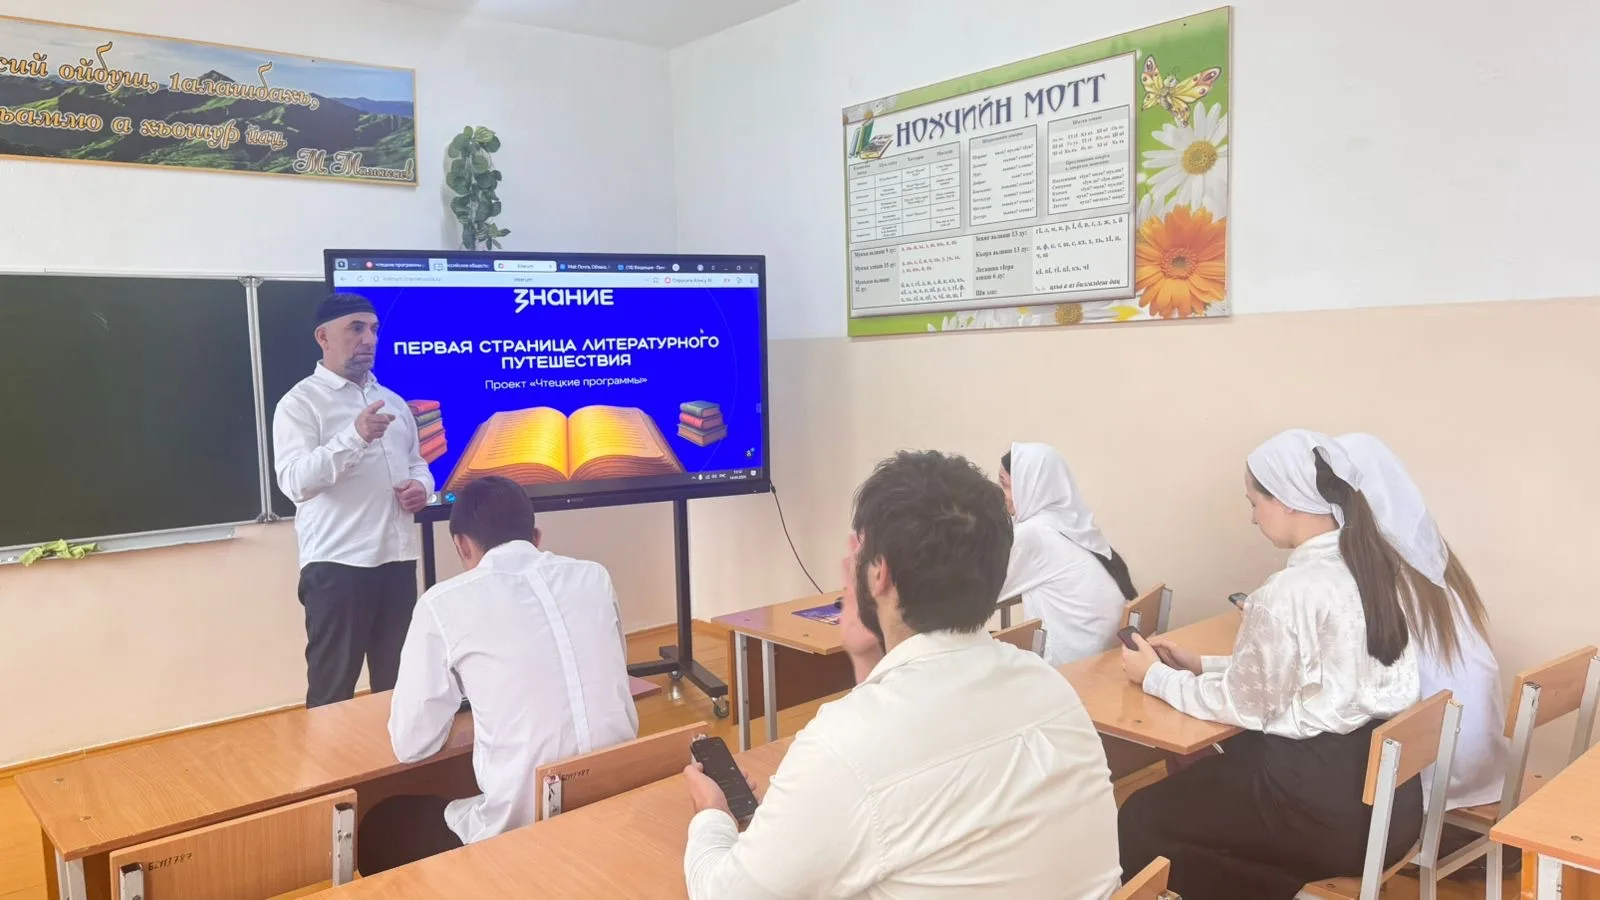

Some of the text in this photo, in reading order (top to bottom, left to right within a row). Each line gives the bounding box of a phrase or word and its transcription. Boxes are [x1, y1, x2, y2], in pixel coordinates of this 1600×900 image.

[896, 95, 1013, 149] НОХЧИЙН
[1024, 73, 1106, 118] МОТТ
[111, 116, 134, 136] а
[139, 119, 241, 150] хьошур
[394, 335, 720, 356] ПЕРВАЯ СТРАНИЦА ЛИТЕРАТУРНОГО
[501, 353, 632, 370] ПУТЕШЕСТВИЯ
[485, 376, 648, 391] Проект «Чтецкие программы»
